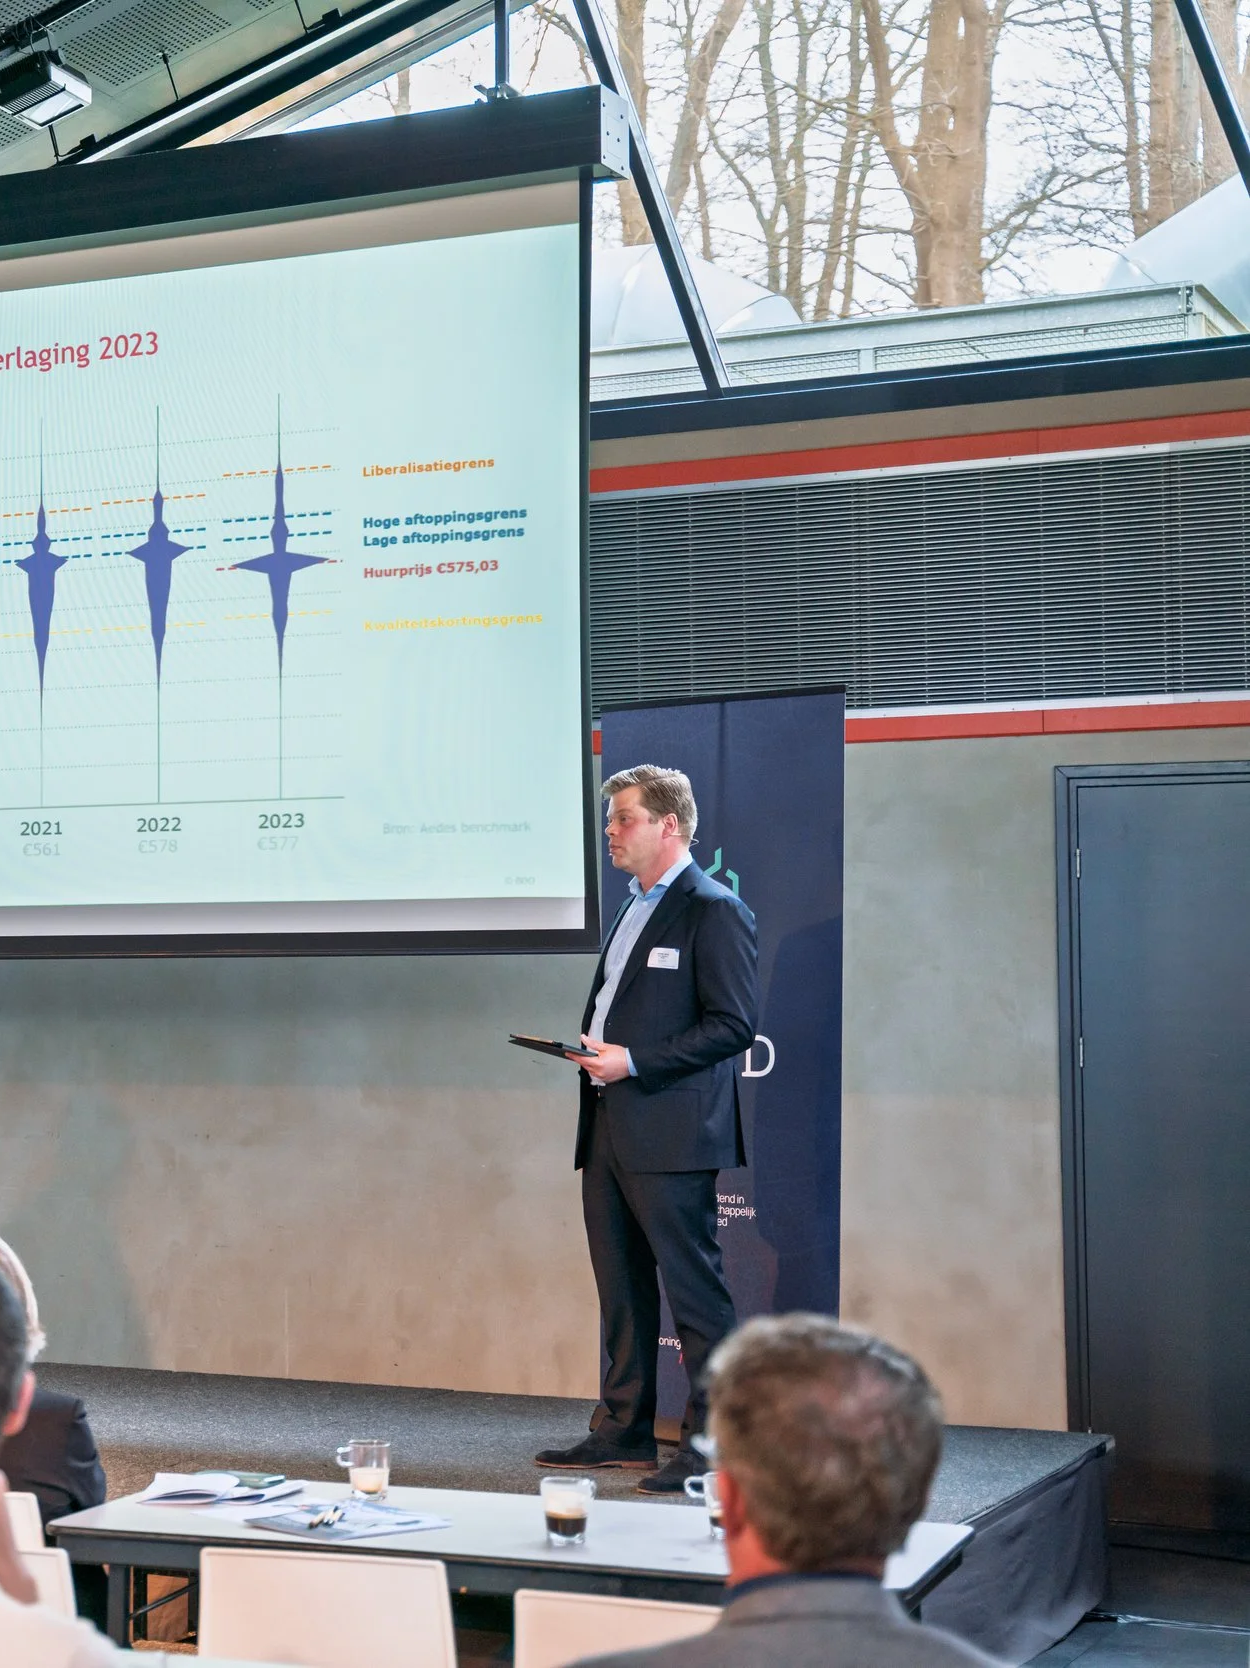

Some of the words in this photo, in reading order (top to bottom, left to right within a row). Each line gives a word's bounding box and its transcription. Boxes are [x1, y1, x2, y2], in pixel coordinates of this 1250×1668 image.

[99, 331, 159, 360] 2023
[362, 458, 495, 477] Liberalisatiegrens
[363, 516, 400, 529] Hoge
[404, 508, 527, 527] aftoppingsgrens
[363, 535, 398, 548] Lage
[402, 526, 525, 545] aftoppingsgrens
[363, 564, 432, 579] Huurprijs
[436, 560, 499, 575] €575,03
[19, 821, 63, 836] 2021
[136, 817, 182, 832] 2022
[258, 813, 306, 829] 2023
[420, 821, 457, 834] Aedes
[461, 820, 532, 833] benchmark
[22, 842, 61, 857] €561
[137, 839, 178, 853] €578
[256, 836, 299, 851] €577
[736, 1194, 745, 1205] in
[717, 1204, 757, 1220] happelijk
